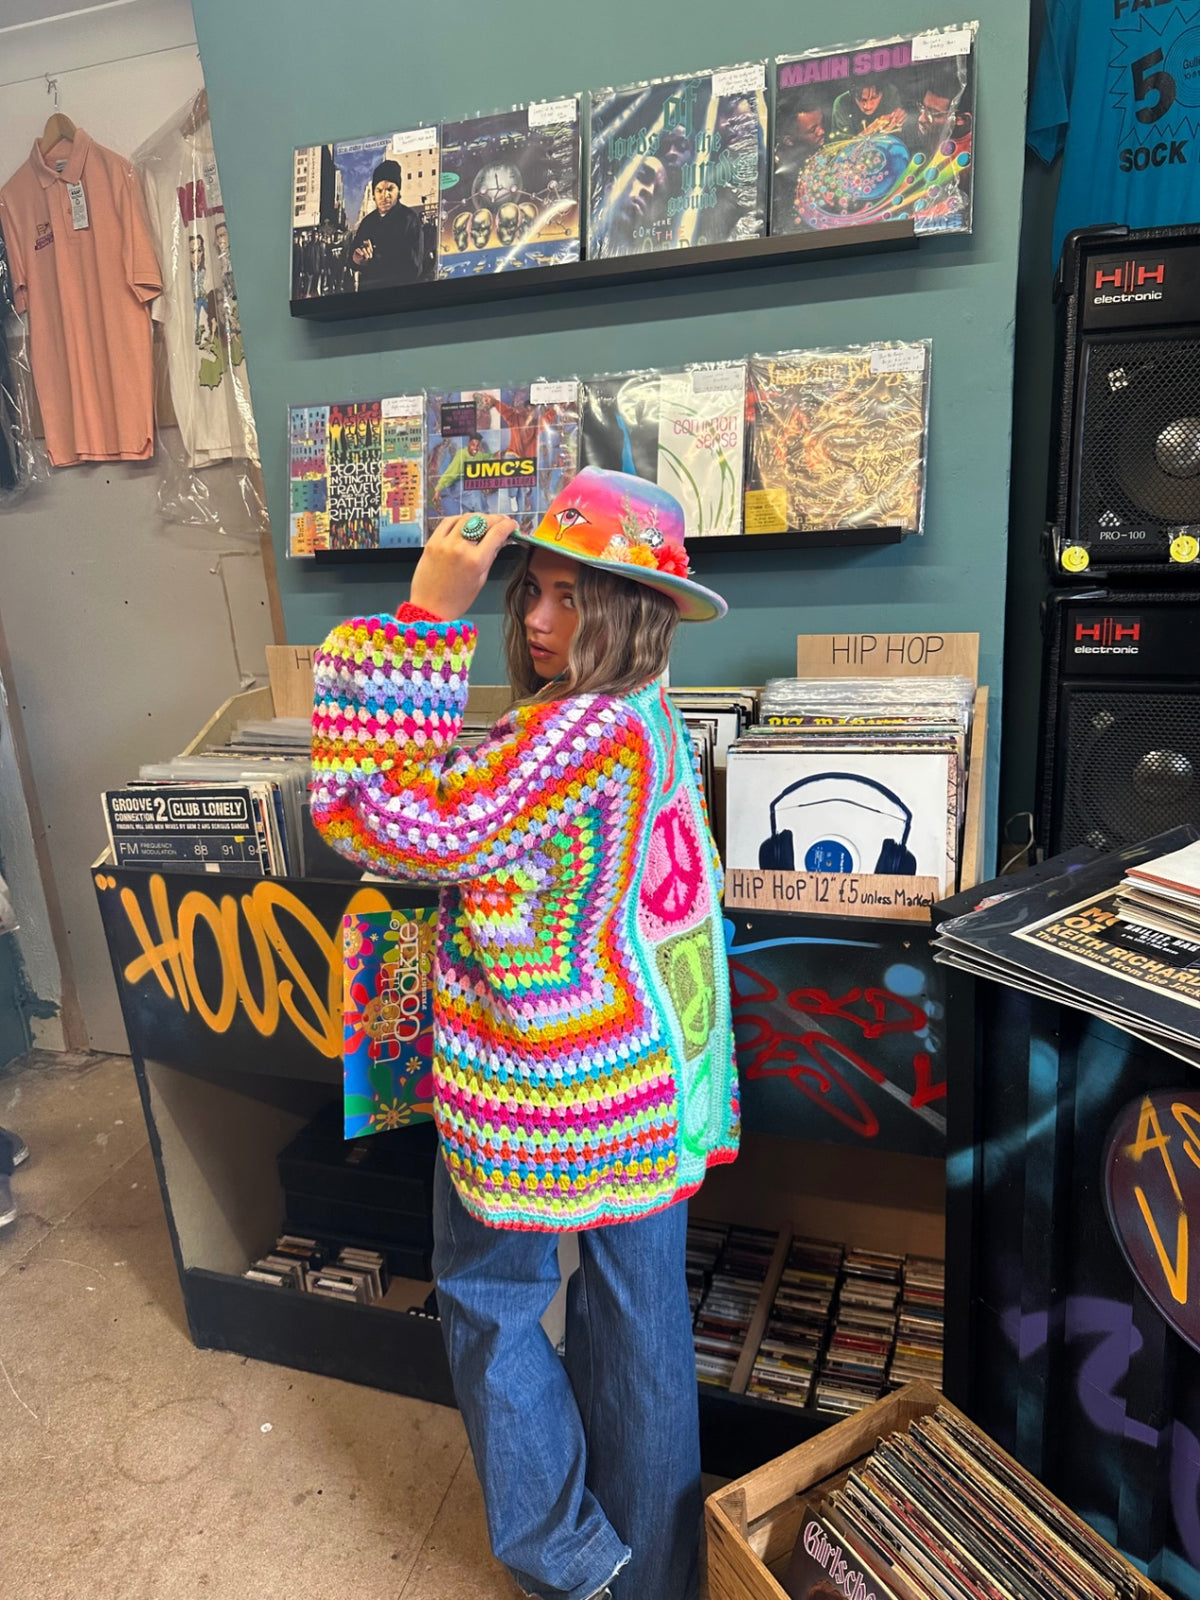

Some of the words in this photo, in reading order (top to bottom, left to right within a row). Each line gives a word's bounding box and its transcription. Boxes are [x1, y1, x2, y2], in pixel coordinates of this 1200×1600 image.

[780, 55, 850, 89] MAIN
[1131, 47, 1176, 125] 5
[1119, 140, 1188, 172] SOCK
[1094, 290, 1162, 305] electronic
[673, 416, 738, 435] common
[696, 431, 738, 449] sense
[466, 460, 535, 478] UMC'S
[329, 482, 382, 496] TRAVELS
[329, 494, 371, 509] PATHS
[329, 506, 382, 521] RHYTHM
[1099, 530, 1146, 541] PRO-100
[831, 635, 877, 665] HIP
[886, 635, 944, 665] HOP
[1074, 645, 1139, 654] electronic
[112, 797, 153, 812] GROOVE
[153, 797, 169, 822] 2
[172, 802, 200, 816] CLUB
[203, 801, 243, 816] LONELY
[114, 812, 155, 822] CONNEKTION
[119, 842, 139, 855] FM
[194, 845, 209, 856] 88
[222, 845, 235, 856] 91
[839, 879, 859, 904] £5
[860, 888, 892, 906] unless
[1063, 916, 1108, 935] OF
[1044, 924, 1108, 951] KEITH
[1036, 930, 1056, 943] The
[1058, 940, 1110, 963] creature
[1111, 960, 1143, 978] from
[1145, 973, 1168, 986] the
[394, 921, 421, 1043] Cookie
